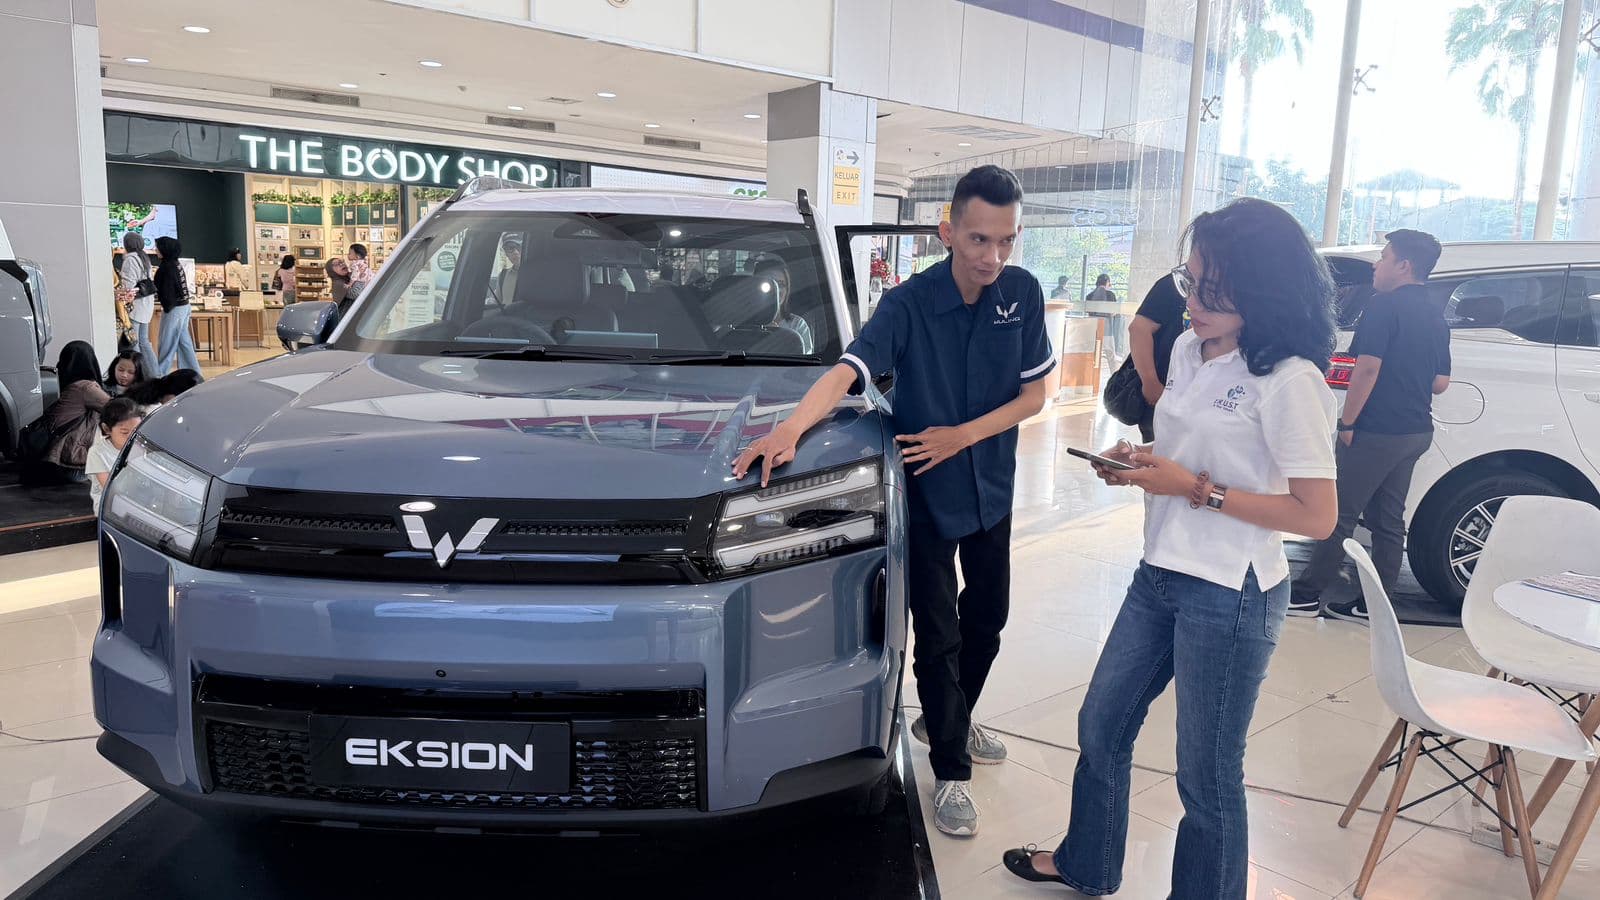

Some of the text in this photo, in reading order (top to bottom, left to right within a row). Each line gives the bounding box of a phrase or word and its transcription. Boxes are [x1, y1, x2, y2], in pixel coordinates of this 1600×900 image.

[239, 134, 548, 186] THE BODY SHOP
[834, 172, 859, 181] KELUAR
[837, 192, 856, 200] EXIT
[345, 738, 534, 771] EKSION
